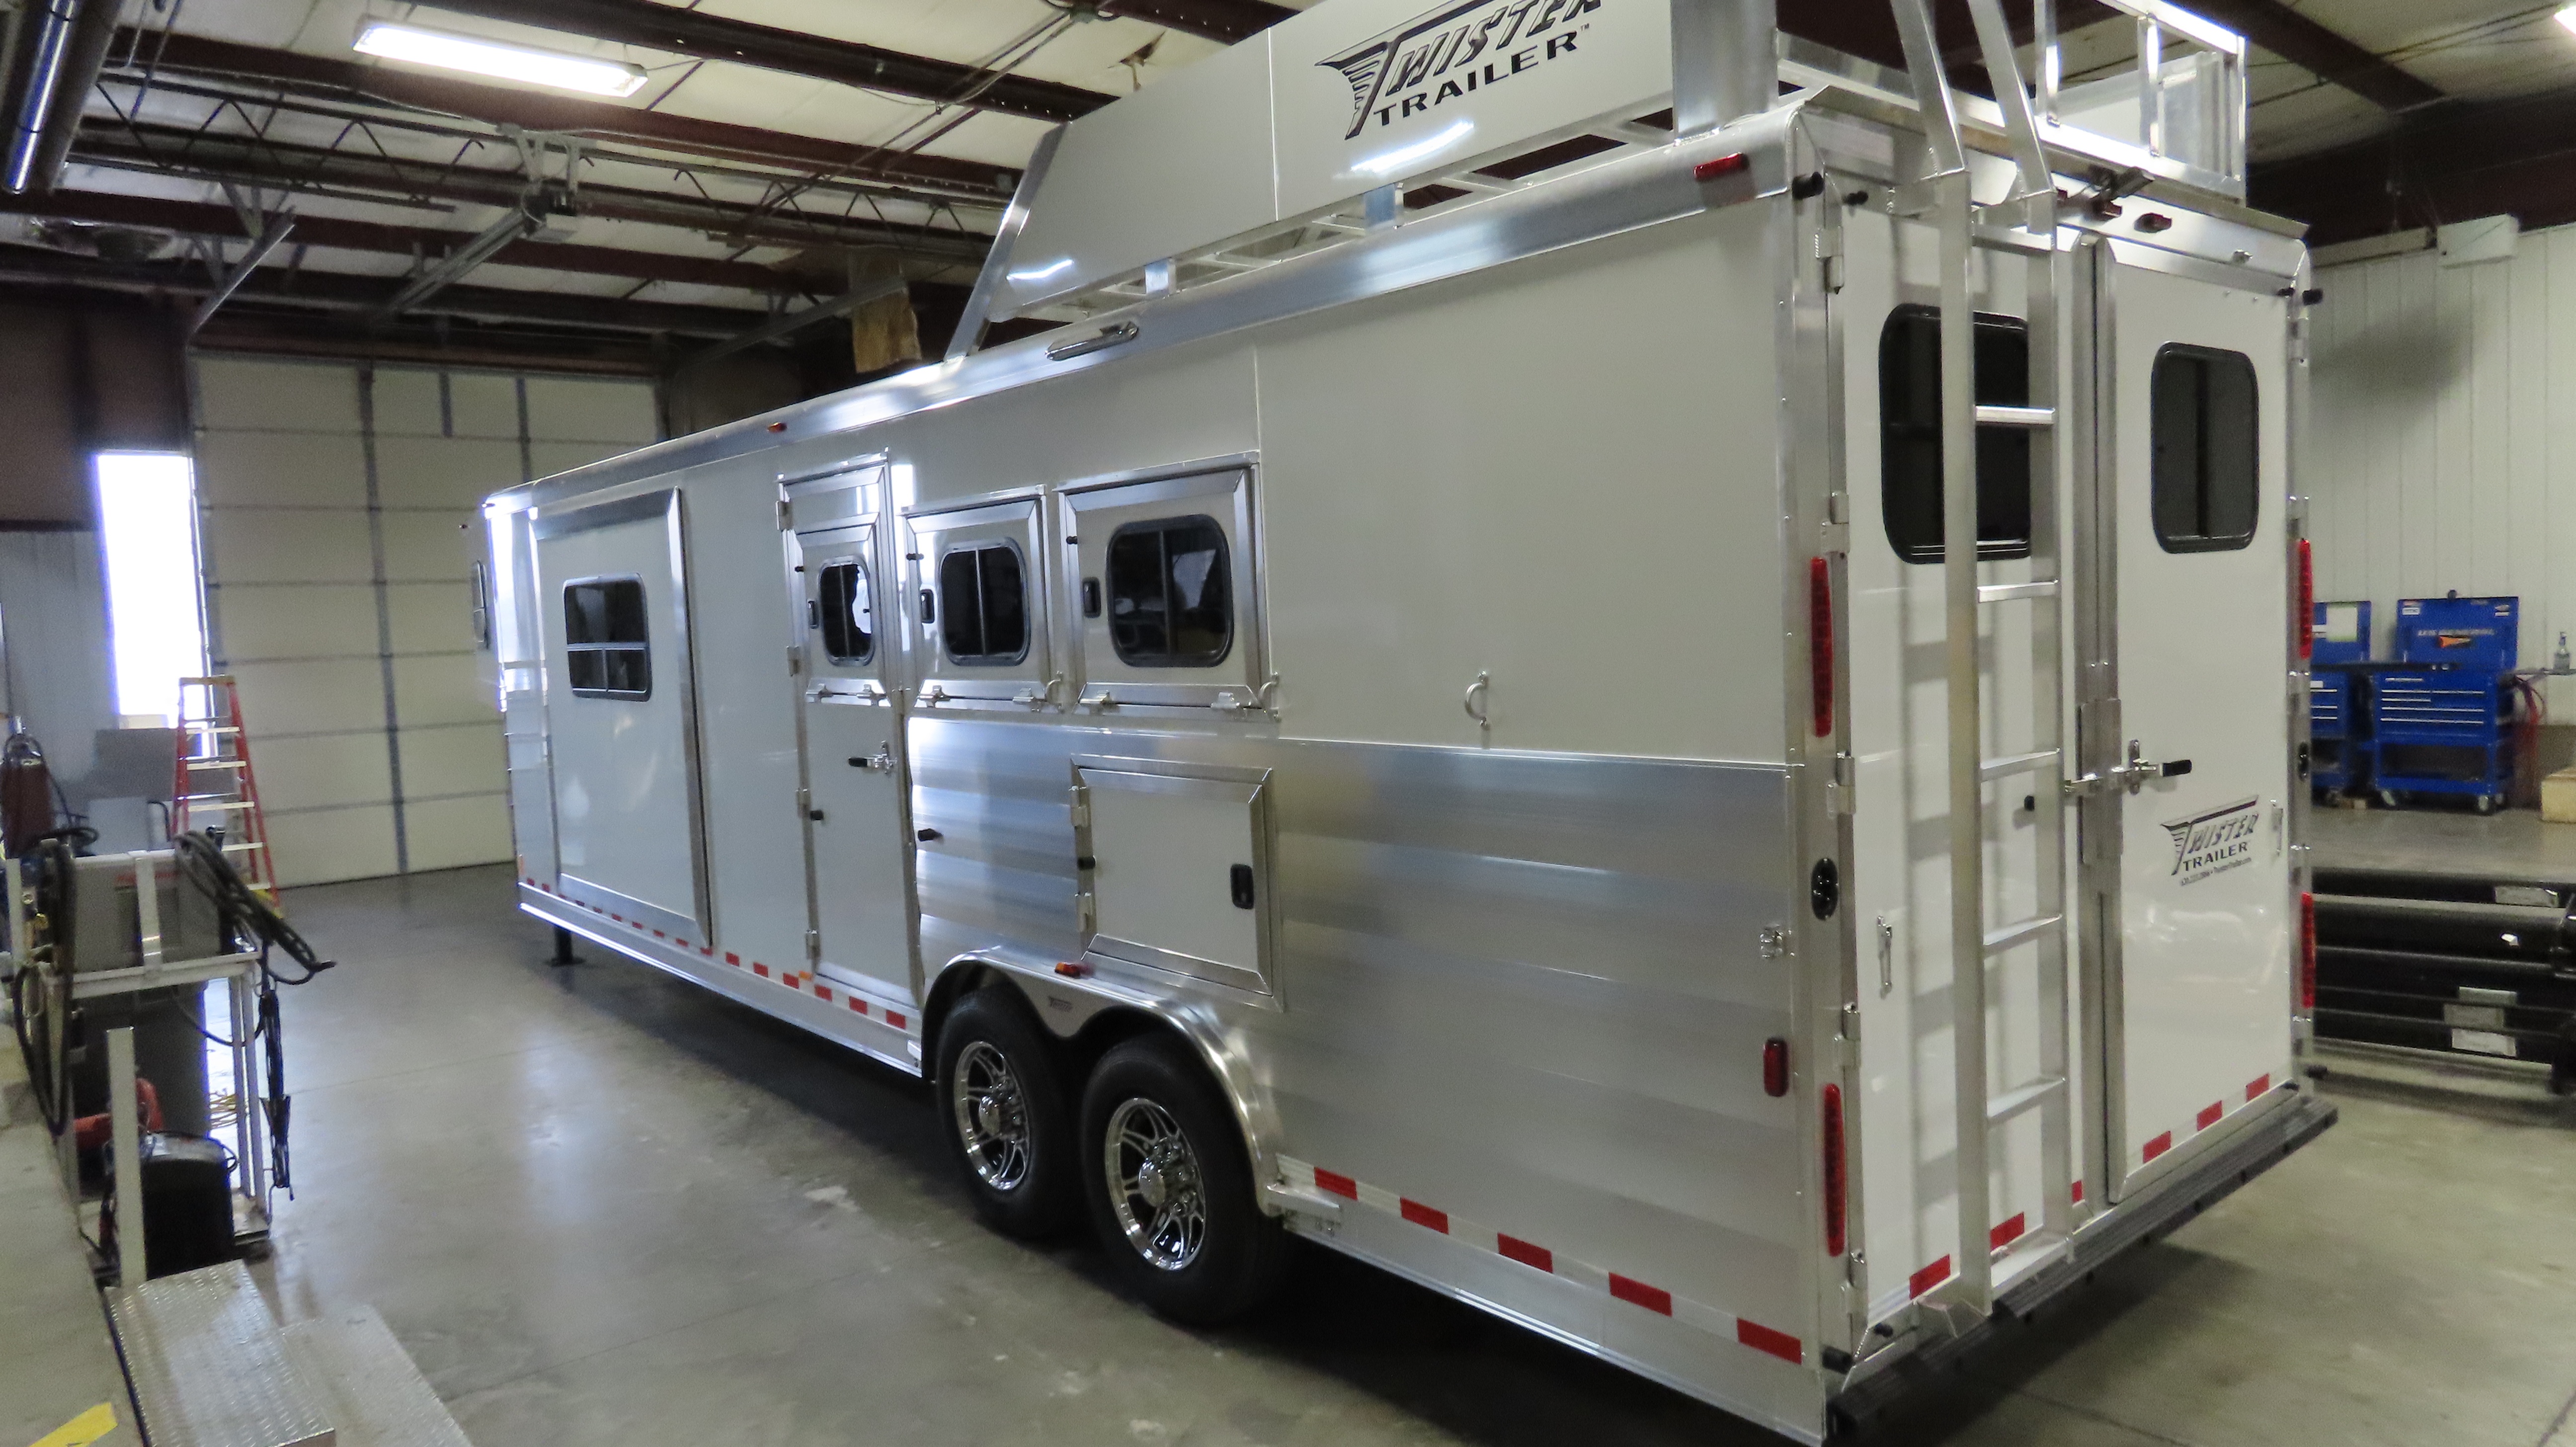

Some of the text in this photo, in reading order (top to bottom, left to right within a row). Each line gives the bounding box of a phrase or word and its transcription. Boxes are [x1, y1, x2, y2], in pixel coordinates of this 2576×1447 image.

[1373, 31, 1577, 126] TRAILER
[2160, 795, 2259, 876] TWISTER
[2182, 842, 2248, 872] TRAILER
